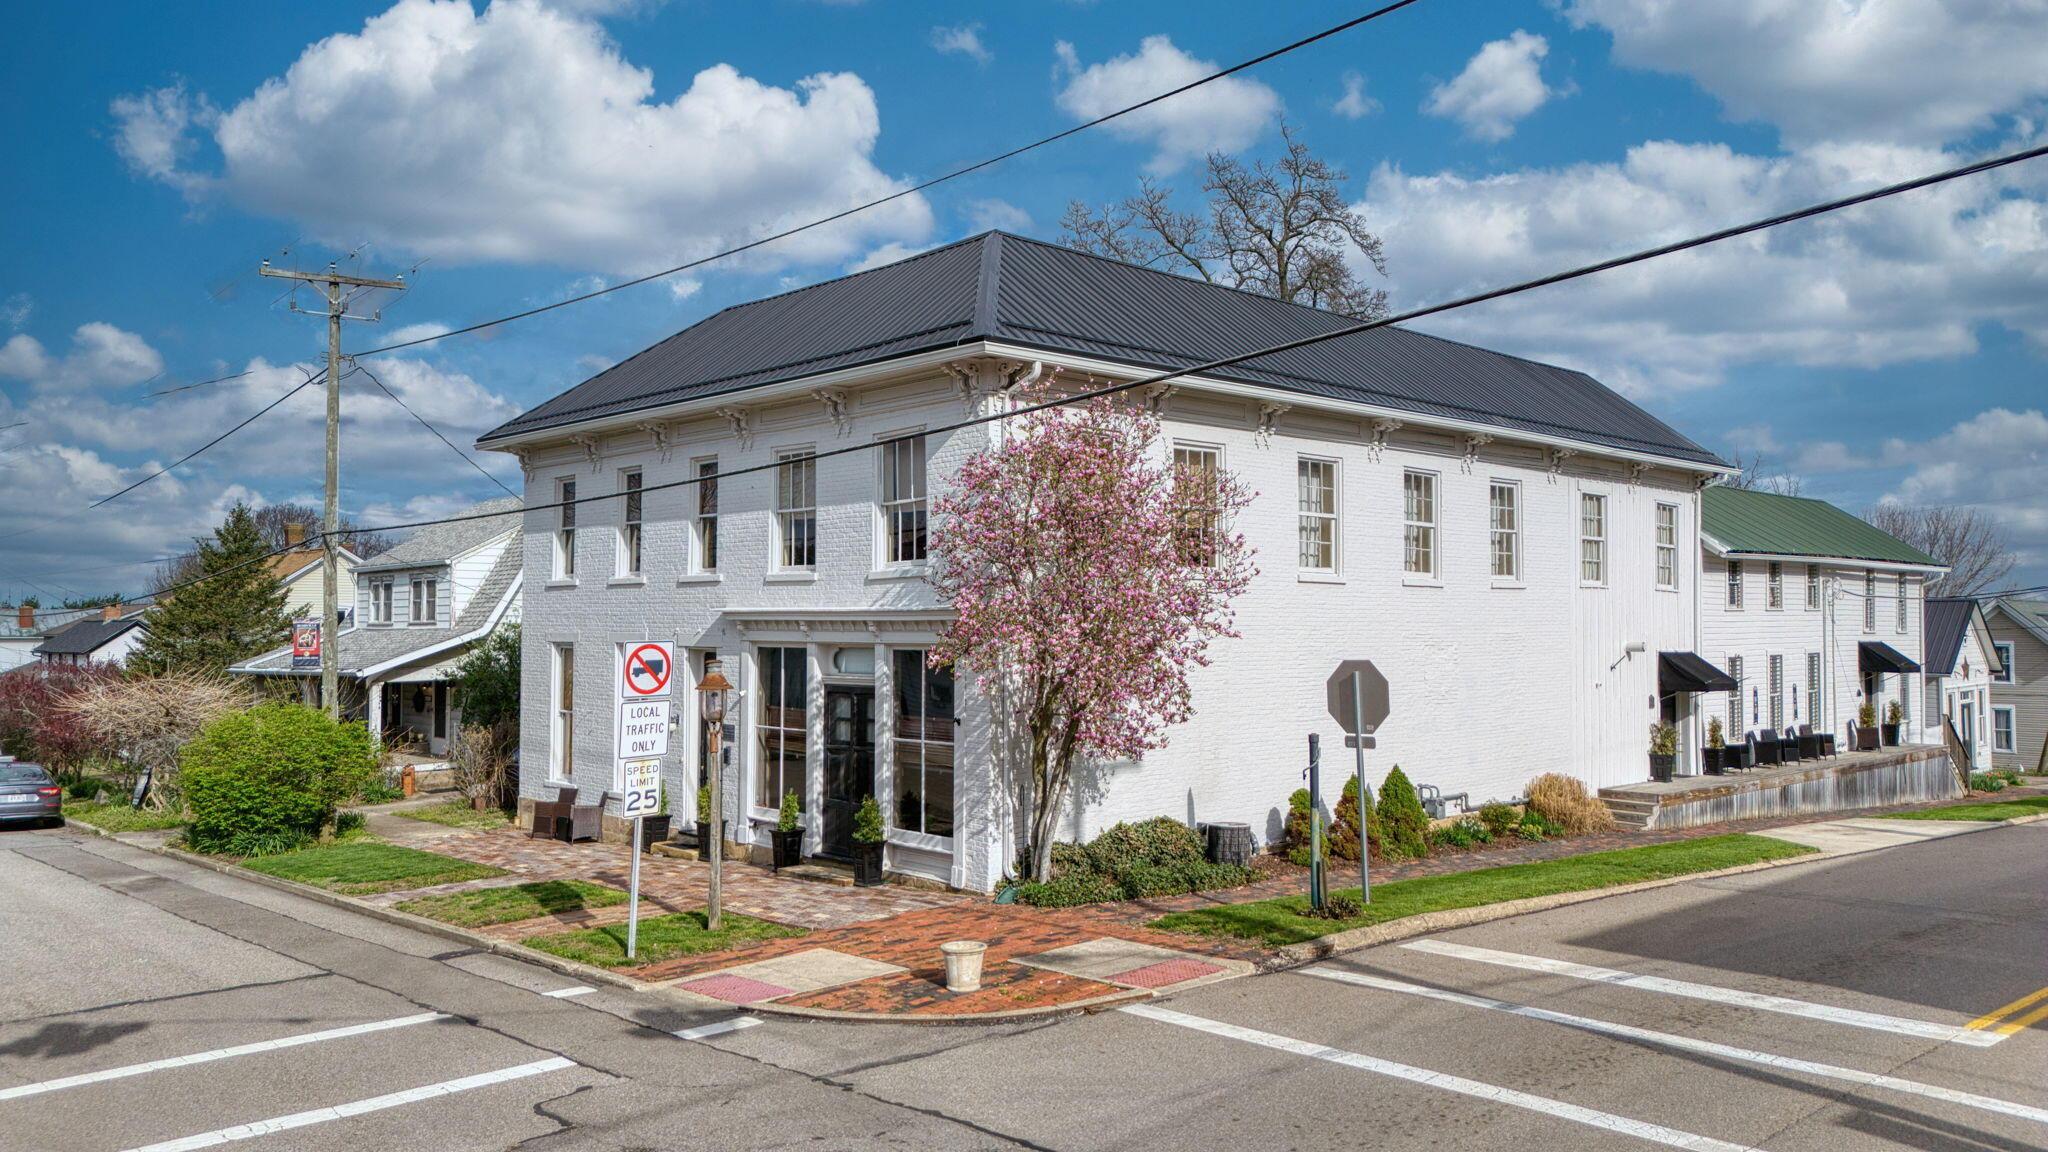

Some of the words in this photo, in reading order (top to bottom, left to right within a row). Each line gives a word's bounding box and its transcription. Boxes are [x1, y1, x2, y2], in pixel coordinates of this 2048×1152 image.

[631, 706, 660, 718] LOCAL
[626, 722, 664, 735] TRAFFIC
[632, 740, 656, 752] ONLY
[627, 764, 659, 775] SPEED
[630, 777, 655, 787] LIMIT
[627, 788, 657, 811] 25
